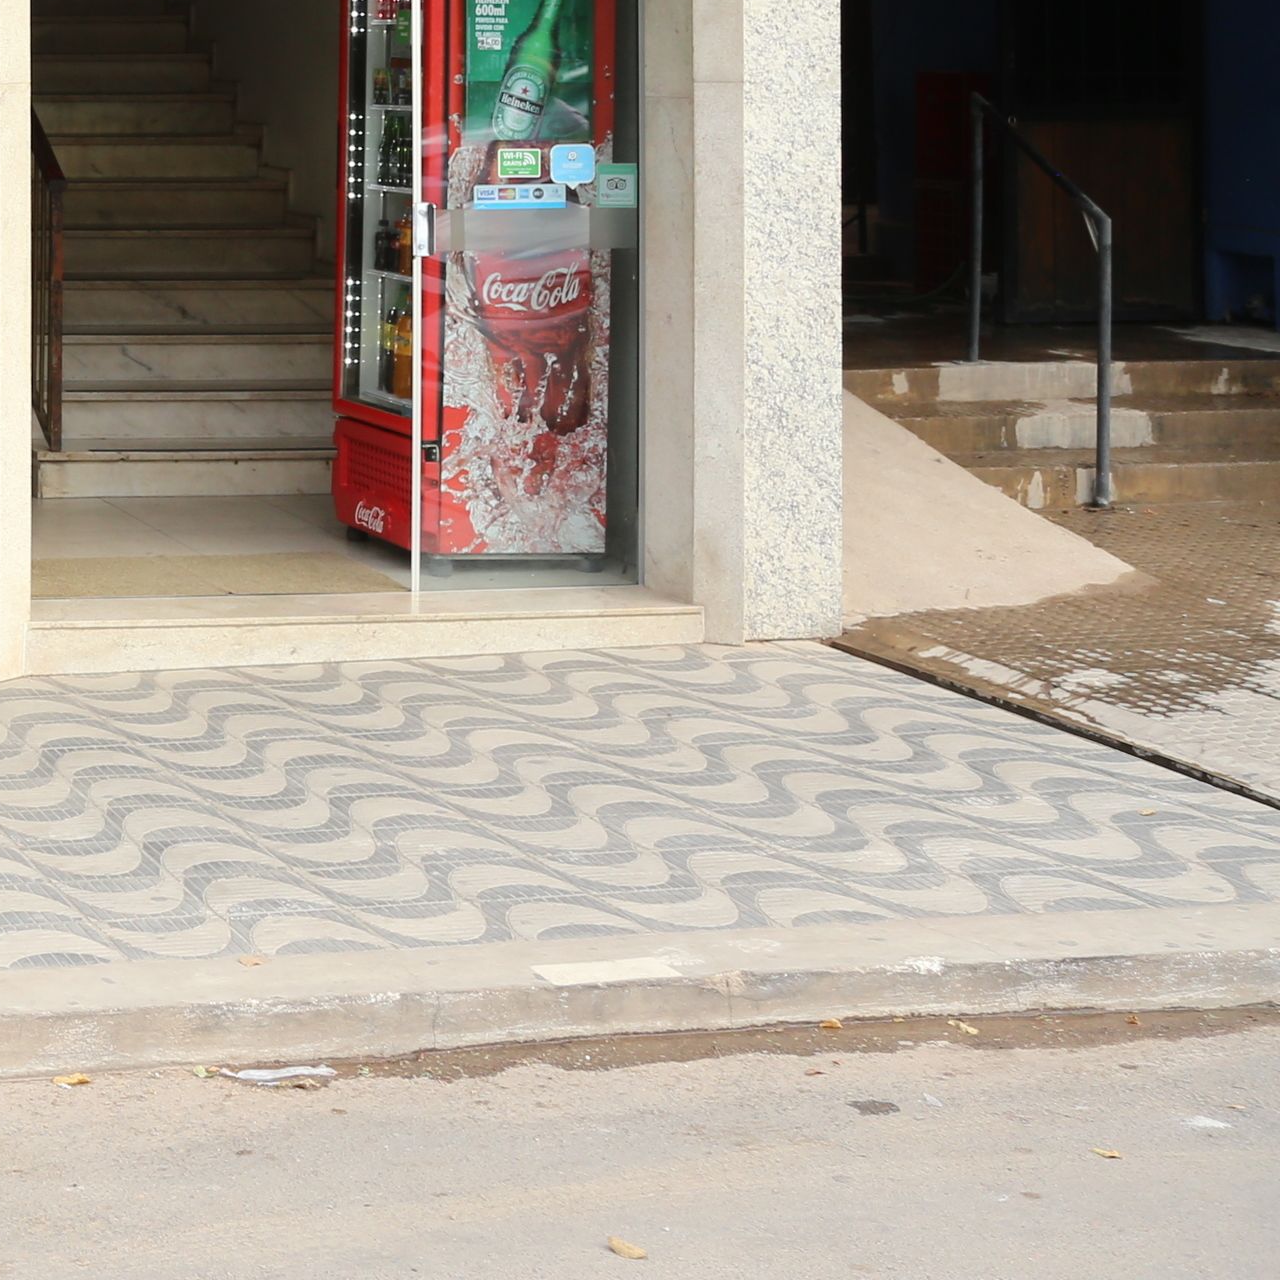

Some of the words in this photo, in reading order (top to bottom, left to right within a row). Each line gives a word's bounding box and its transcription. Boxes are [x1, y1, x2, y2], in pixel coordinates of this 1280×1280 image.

[475, 5, 505, 16] 600ml
[501, 93, 541, 114] Heineken
[480, 189, 495, 197] VISA
[483, 261, 580, 311] Coca-Cola
[355, 499, 385, 533] Coca-Cola
